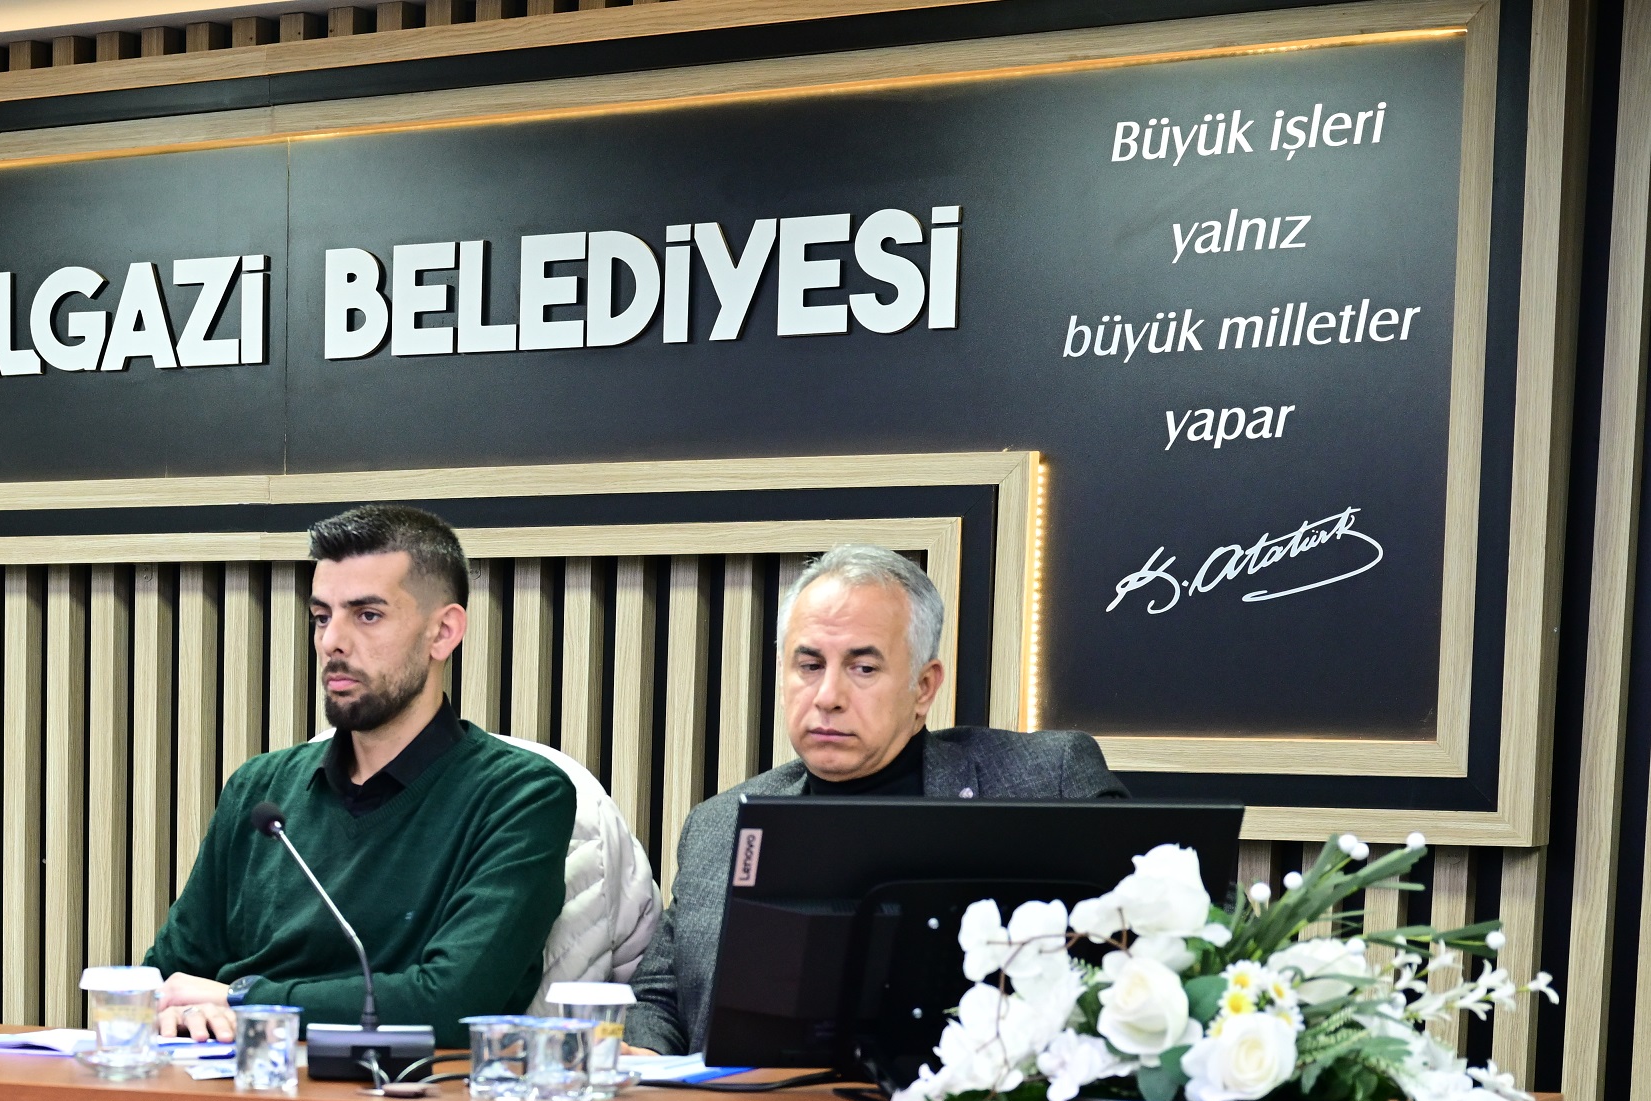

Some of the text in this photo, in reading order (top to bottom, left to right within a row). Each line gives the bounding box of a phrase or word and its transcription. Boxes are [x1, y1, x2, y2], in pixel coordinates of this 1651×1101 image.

[1111, 101, 1387, 166] Büyük işleri
[1171, 207, 1312, 264] yalnız
[324, 205, 962, 362] BELEDİYESİ
[1063, 298, 1422, 364] büyük milletler
[1164, 404, 1296, 451] yapar
[739, 834, 756, 880] Lenovo
